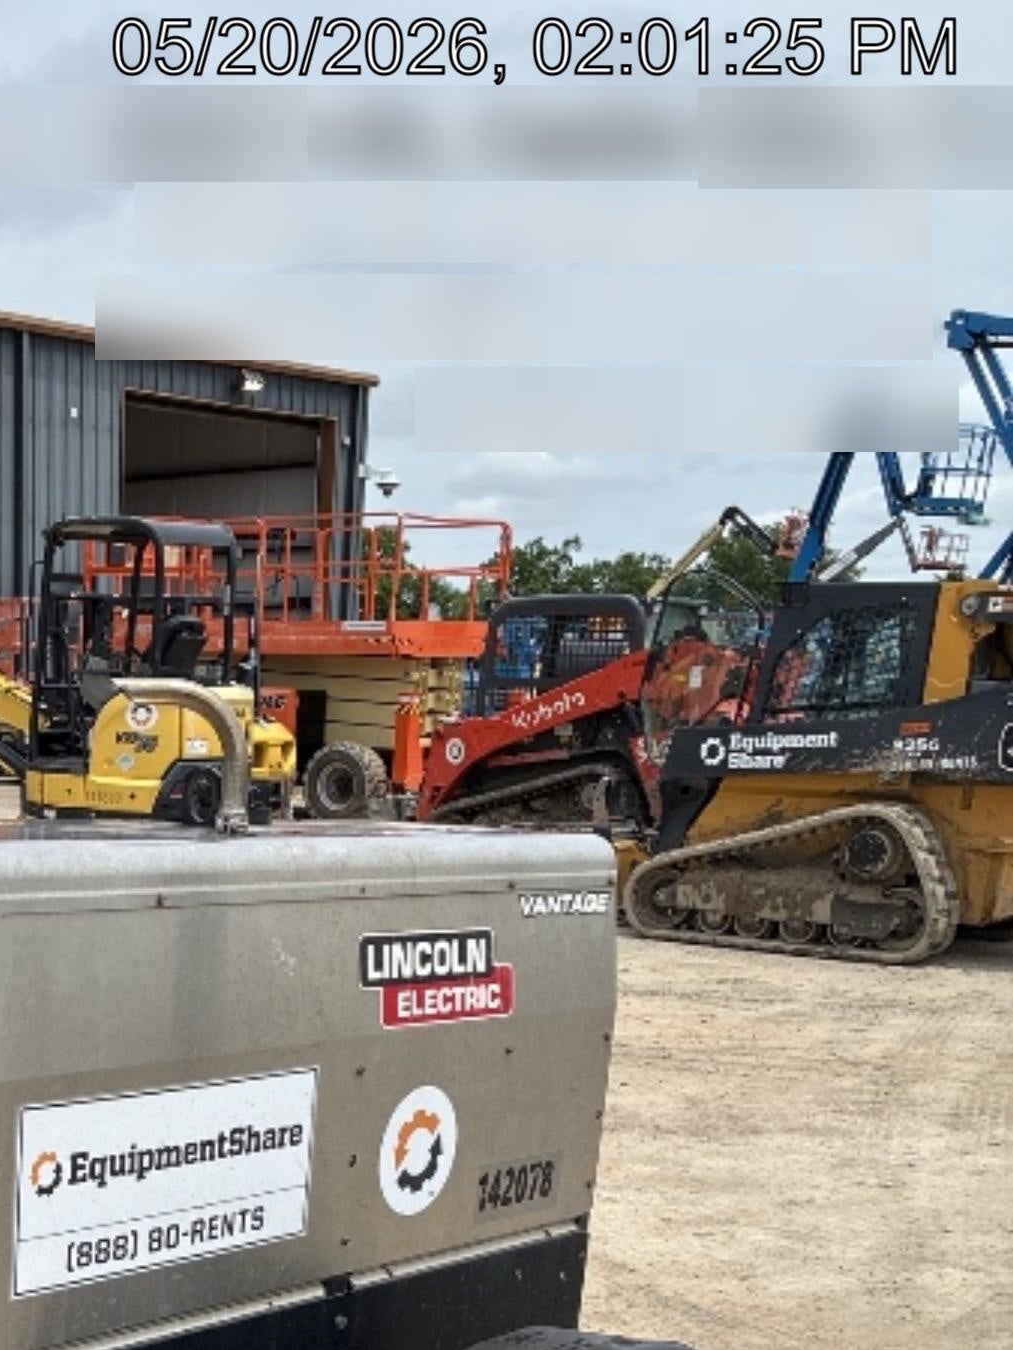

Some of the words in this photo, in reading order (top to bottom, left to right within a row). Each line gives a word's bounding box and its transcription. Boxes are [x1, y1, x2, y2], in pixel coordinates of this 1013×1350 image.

[511, 692, 585, 729] Kubota
[728, 752, 787, 769] Share
[729, 731, 838, 753] Equipment
[519, 892, 611, 917] VANTAGE
[367, 938, 487, 981] LINCOLN
[396, 983, 502, 1018] ELECTRIC
[68, 1123, 303, 1188] EquipmentShare
[478, 1160, 555, 1213] 142078
[66, 1230, 138, 1272] (888)
[148, 1206, 265, 1254] 80-RENTS
